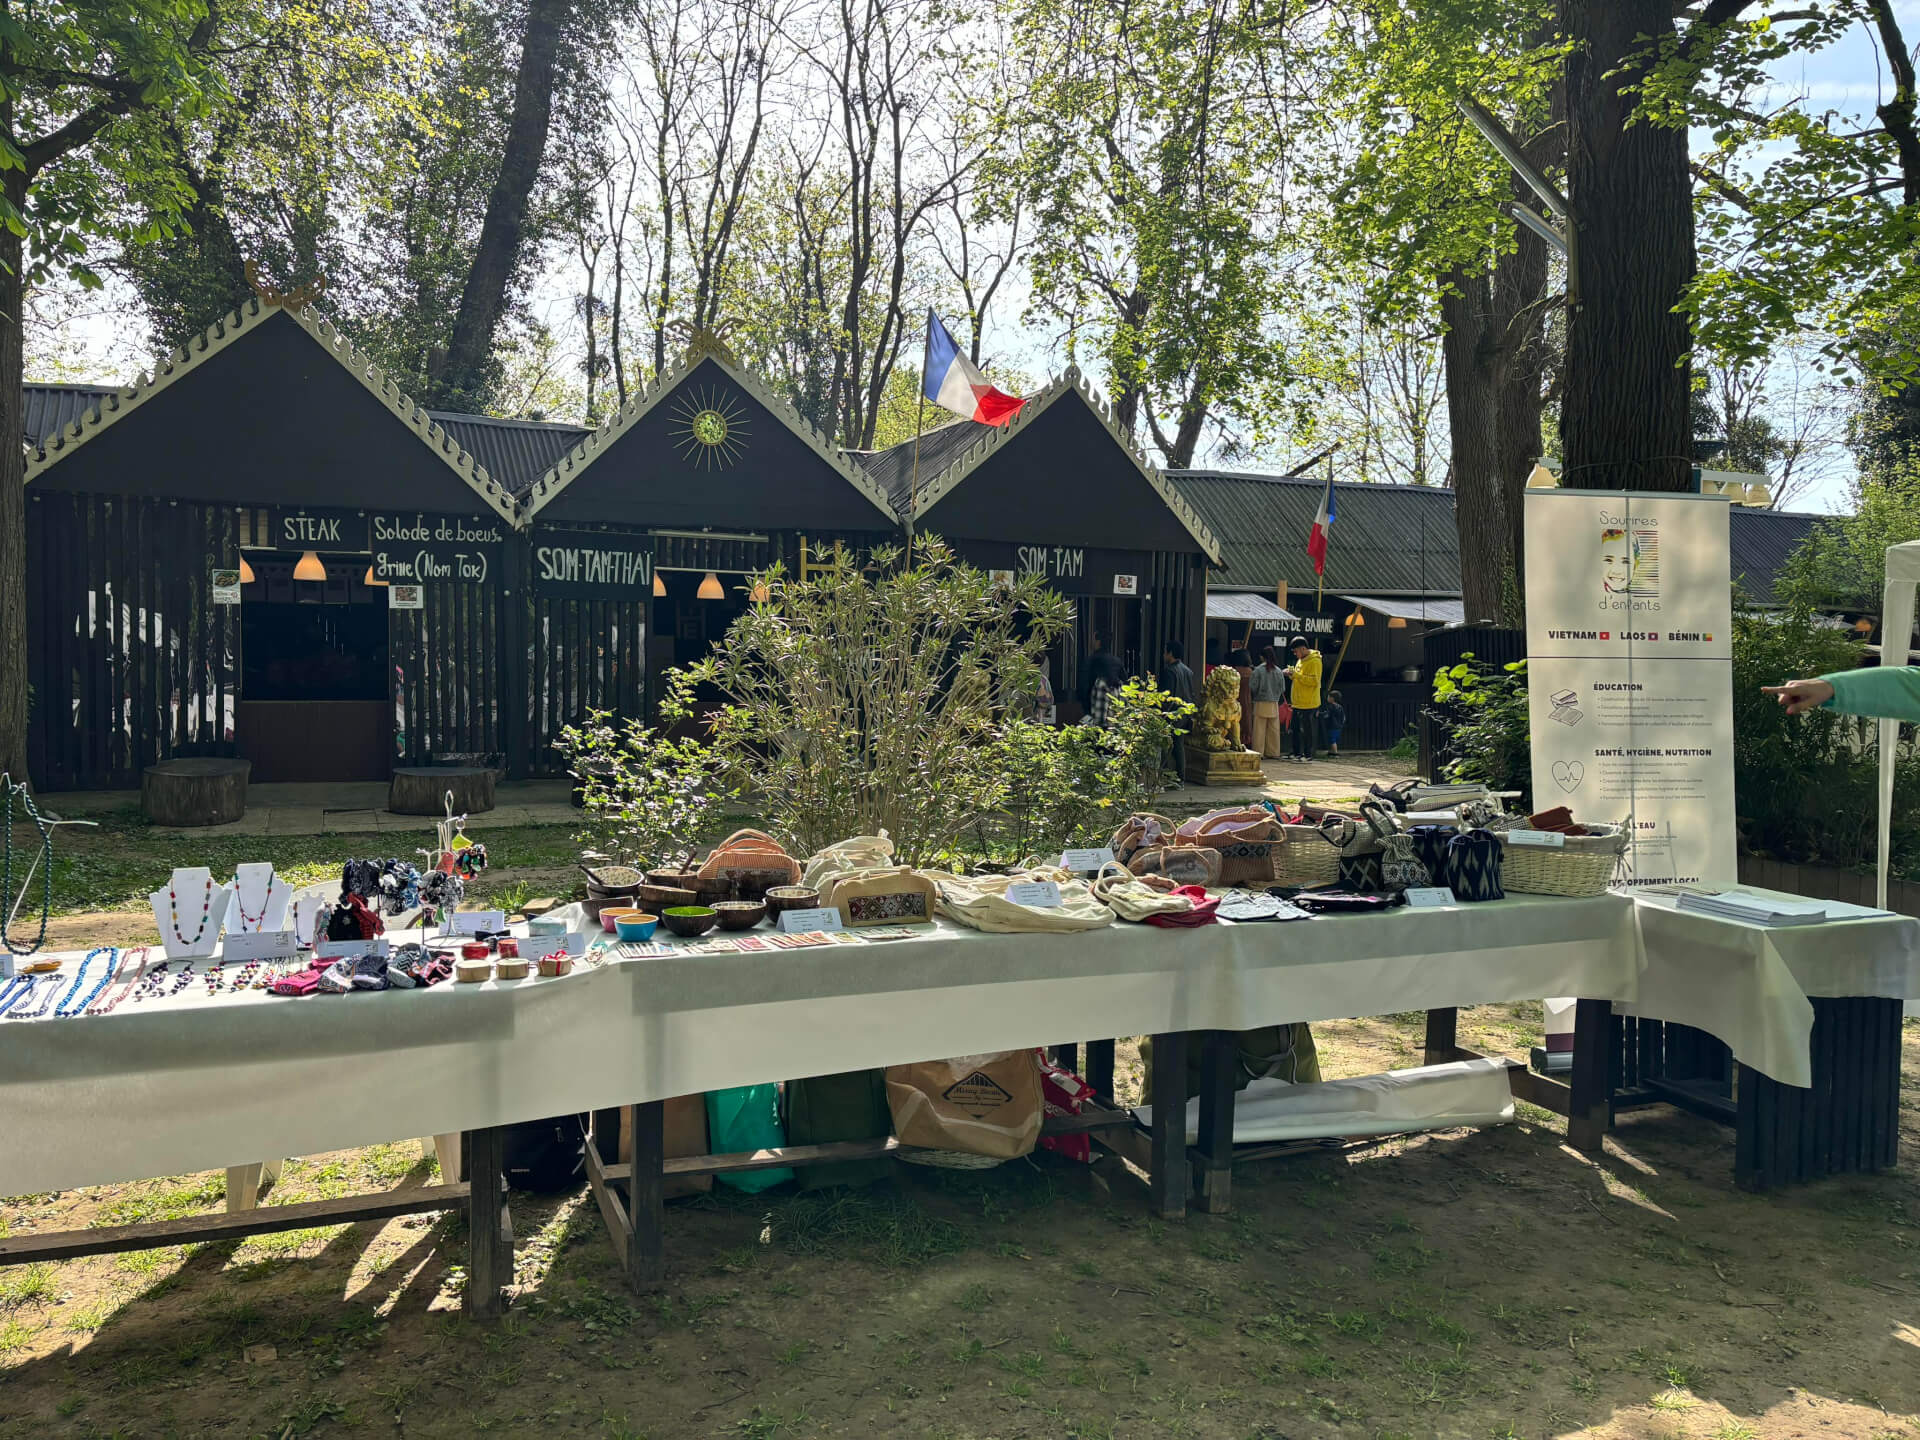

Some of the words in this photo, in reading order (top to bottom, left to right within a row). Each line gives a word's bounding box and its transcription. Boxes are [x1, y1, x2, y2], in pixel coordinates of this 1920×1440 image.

[1599, 510, 1659, 526] Sourires
[284, 517, 341, 541] STEAK
[434, 518, 454, 541] de
[1017, 546, 1084, 577] SOM-TAM
[1598, 594, 1661, 611] d'enfants
[1548, 630, 1597, 640] VIETNAM
[1620, 631, 1646, 641] LAOS
[1668, 629, 1700, 641] BÉNIN
[1593, 681, 1643, 691] ÉDUCATION
[1595, 746, 1625, 757] SANTÉ,
[1626, 747, 1664, 757] HYGIÈNE,
